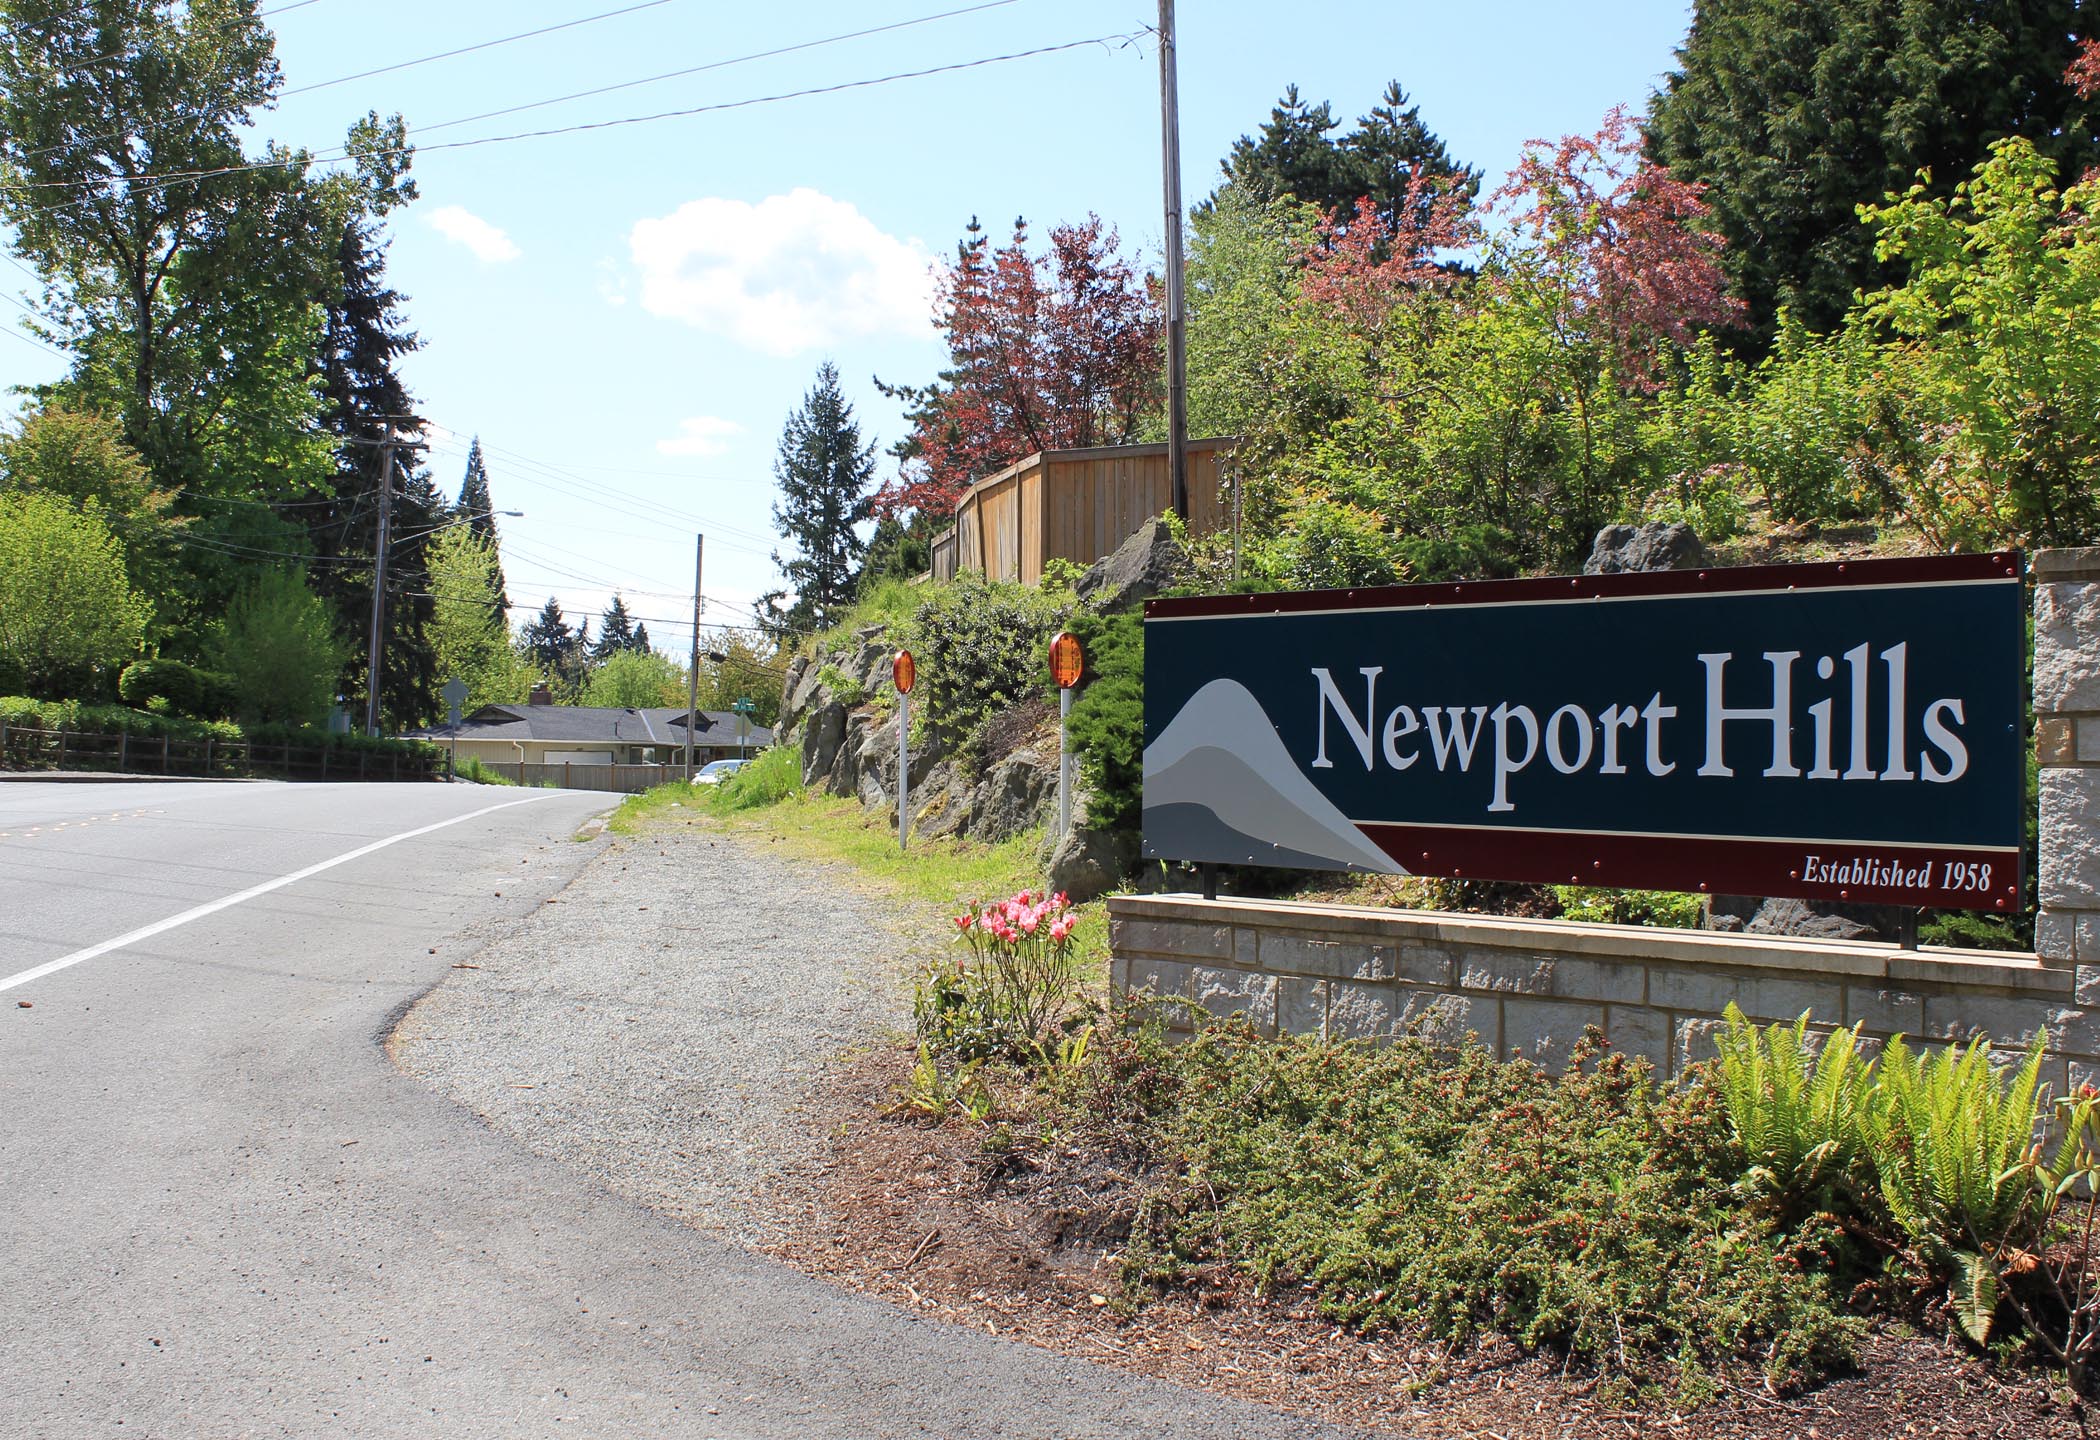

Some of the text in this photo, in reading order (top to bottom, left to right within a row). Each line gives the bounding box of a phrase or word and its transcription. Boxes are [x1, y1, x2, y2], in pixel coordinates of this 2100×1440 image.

[1312, 641, 1968, 811] Newport Hills
[1802, 856, 1992, 891] Established 1958
